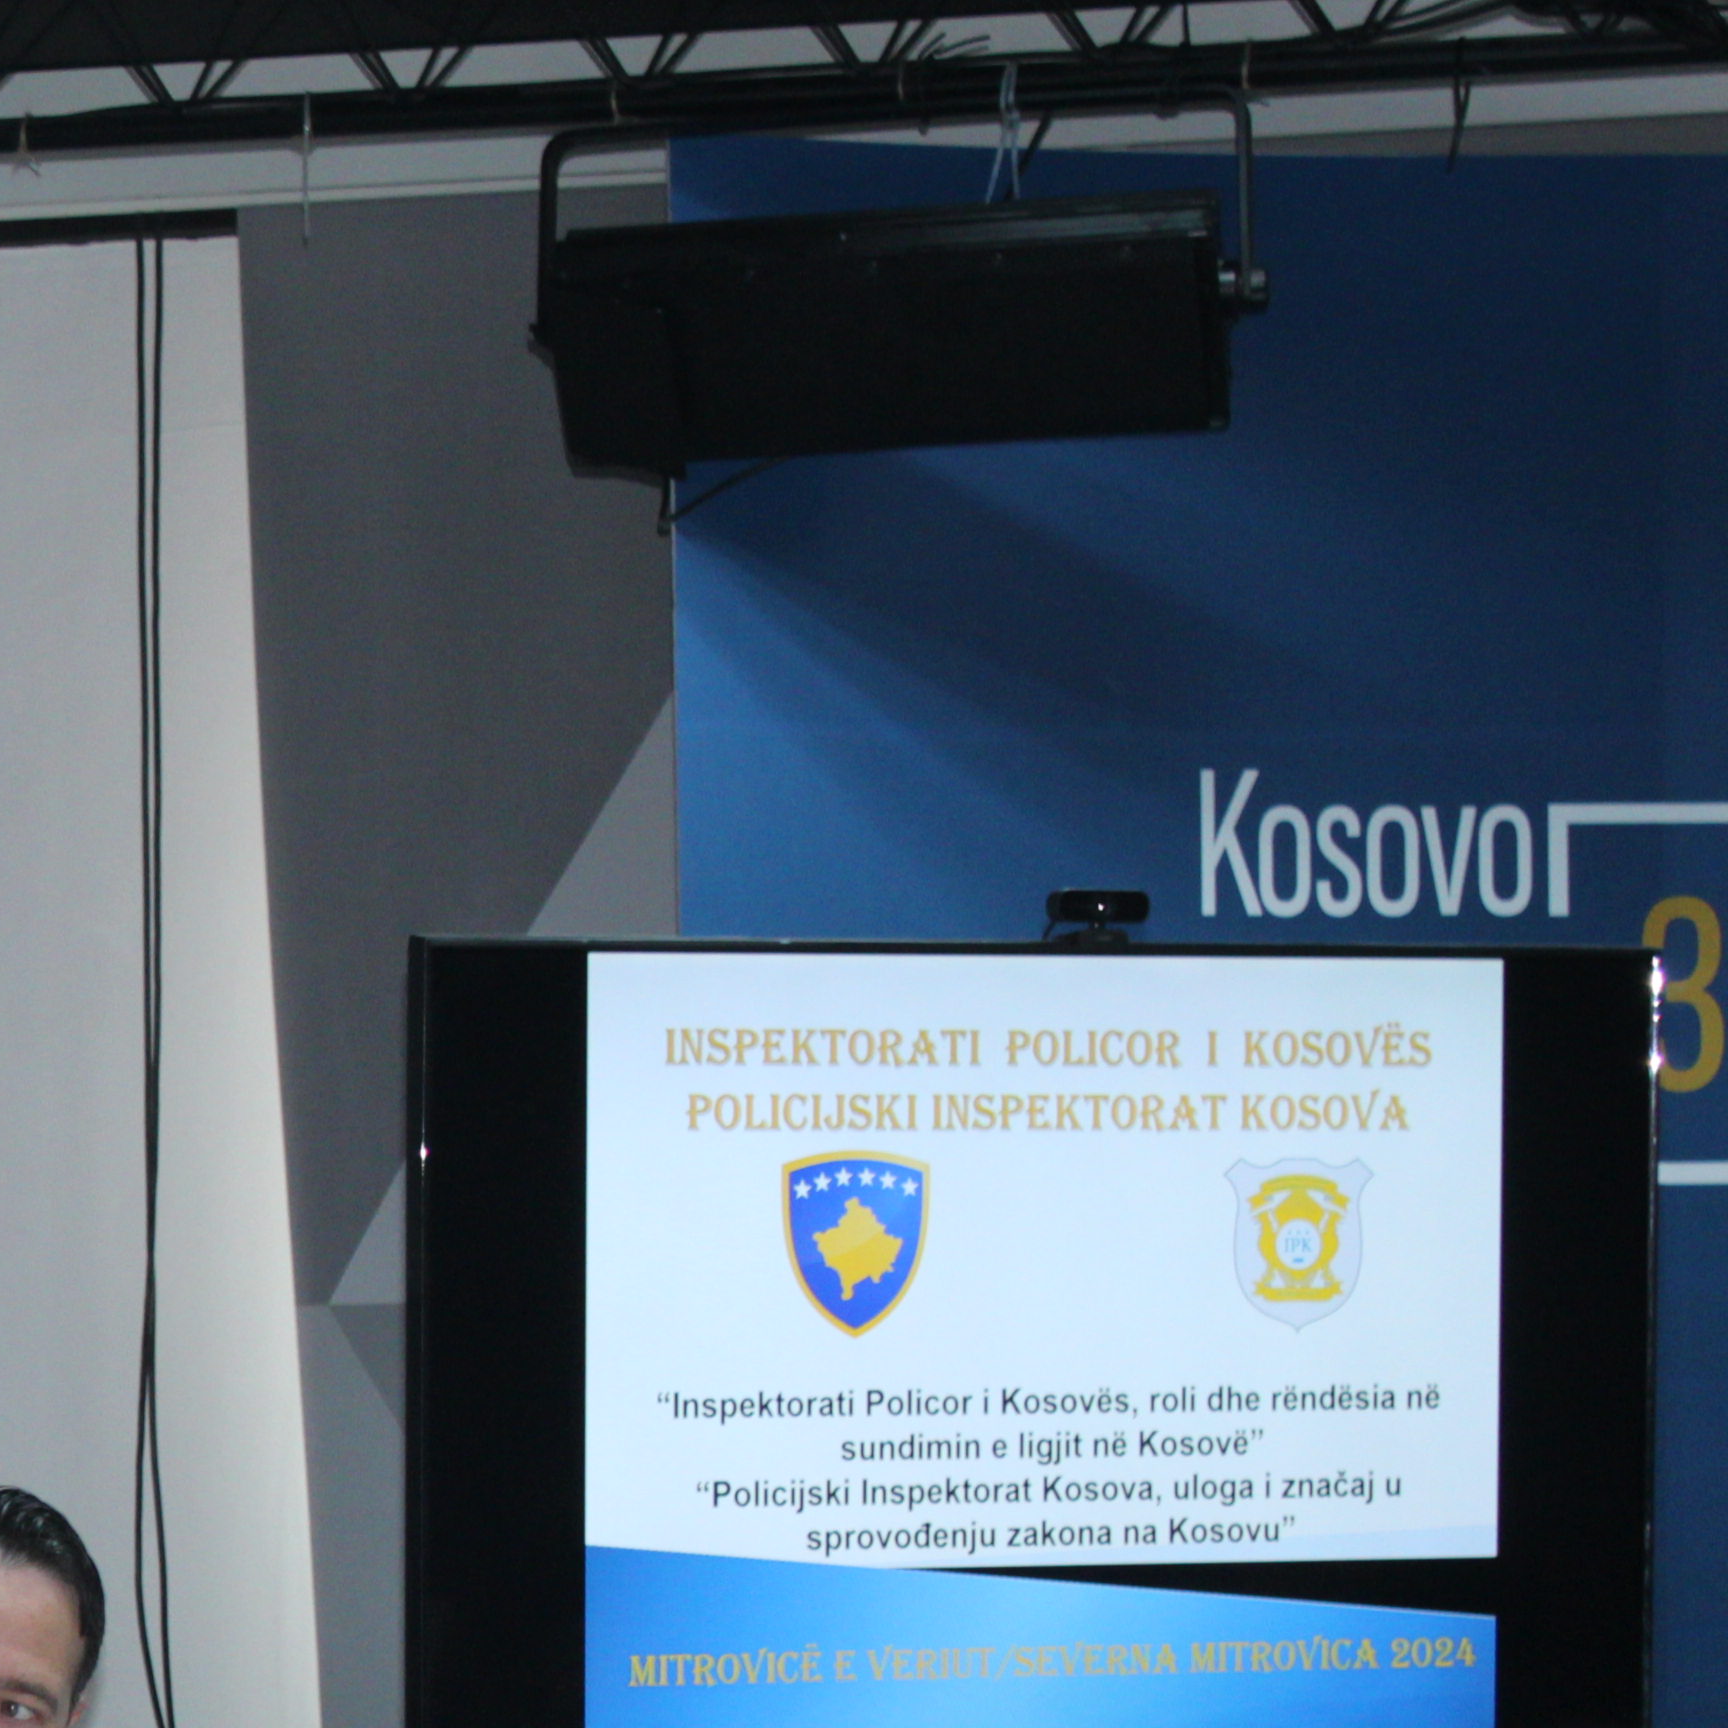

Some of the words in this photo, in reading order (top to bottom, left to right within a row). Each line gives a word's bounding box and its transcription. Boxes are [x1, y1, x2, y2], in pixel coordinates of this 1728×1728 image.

[1200, 768, 1532, 918] Kosovo
[666, 1028, 979, 1067] INSPEKTORATI
[1006, 1029, 1180, 1067] POLICOR
[1208, 1031, 1217, 1066] I
[1244, 1022, 1432, 1067] KOSOVËS
[687, 1093, 916, 1130] POLICIJSKI
[933, 1094, 1227, 1131] INSPEKTORAT
[1242, 1089, 1408, 1130] KOSOVA
[867, 1389, 972, 1416] Policor
[983, 1388, 989, 1414] i
[1002, 1388, 1137, 1419] Kosovës,
[1150, 1386, 1195, 1412] roli
[1207, 1386, 1260, 1411] dhe
[1272, 1385, 1395, 1411] rëndësia
[1407, 1385, 1440, 1409] në
[841, 1434, 980, 1461] sundimin
[992, 1439, 1007, 1459] e
[1020, 1432, 1081, 1465] ligjit
[1093, 1432, 1127, 1457] në
[1139, 1429, 1263, 1456] Kosovë”
[862, 1478, 1031, 1511] Inspektorat
[1043, 1476, 1161, 1507] Kosova,
[1174, 1474, 1253, 1506] uloga
[1265, 1473, 1271, 1498] i
[1282, 1471, 1374, 1504] značaj
[1386, 1478, 1401, 1496] u
[807, 1522, 995, 1556] sprovođenju
[1007, 1521, 1111, 1546] zakona
[1124, 1525, 1156, 1544] na
[1169, 1516, 1295, 1543] Kosovu”
[629, 1644, 822, 1687] MITROVICË
[834, 1650, 857, 1681] E
[867, 1642, 1178, 1680] VERIUT/SEVERNA
[1191, 1635, 1380, 1672] MITROVICA
[1391, 1636, 1476, 1669] 2024
